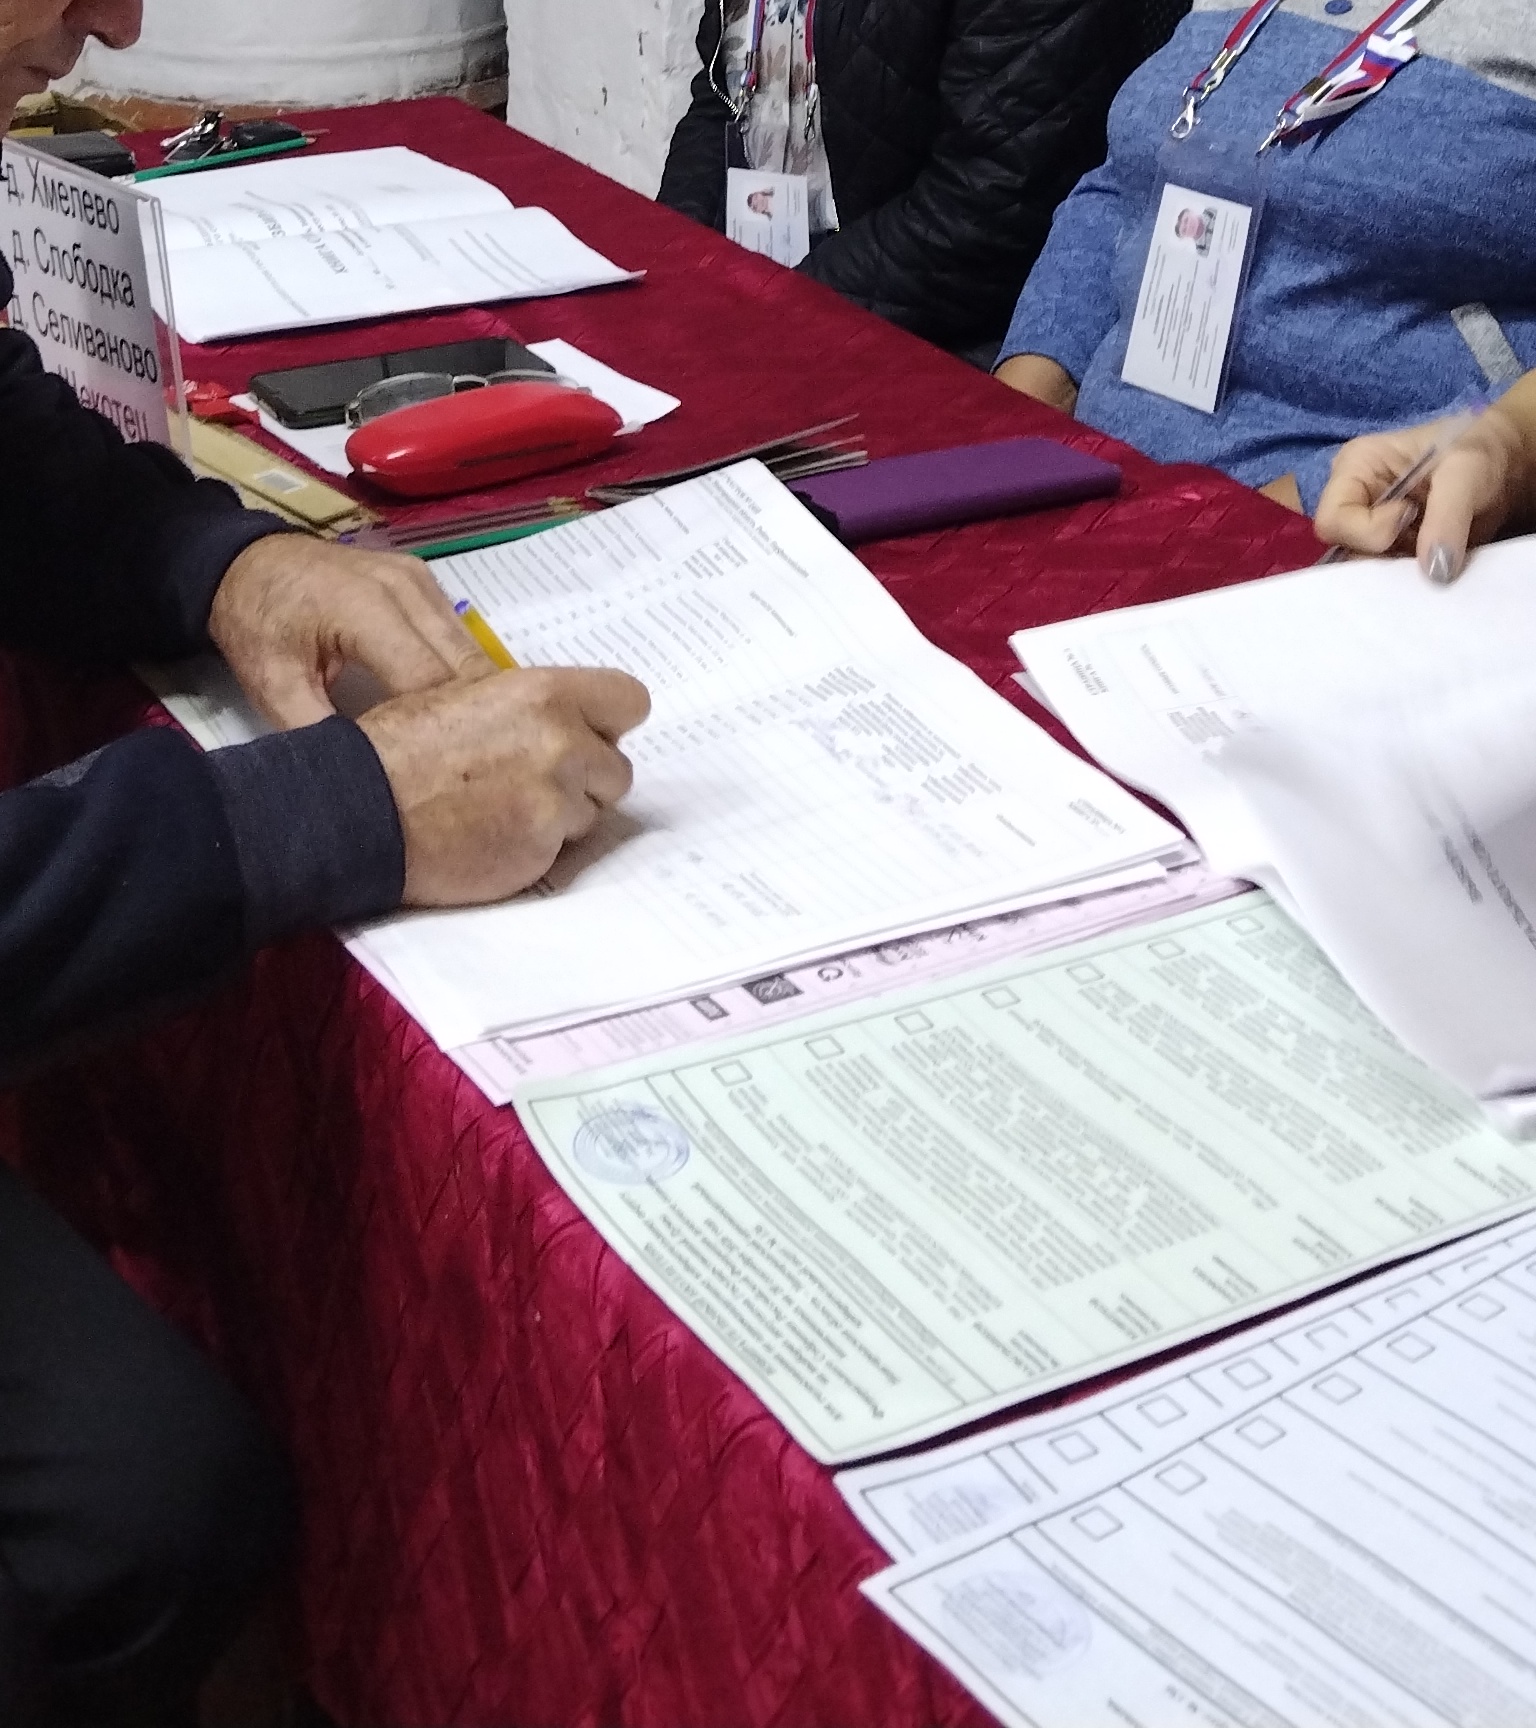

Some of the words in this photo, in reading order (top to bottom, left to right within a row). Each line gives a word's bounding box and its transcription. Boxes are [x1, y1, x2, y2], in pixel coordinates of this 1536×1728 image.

[26, 156, 120, 235] Хмелево
[33, 227, 135, 309] Слободка
[32, 290, 158, 383] Селиваново
